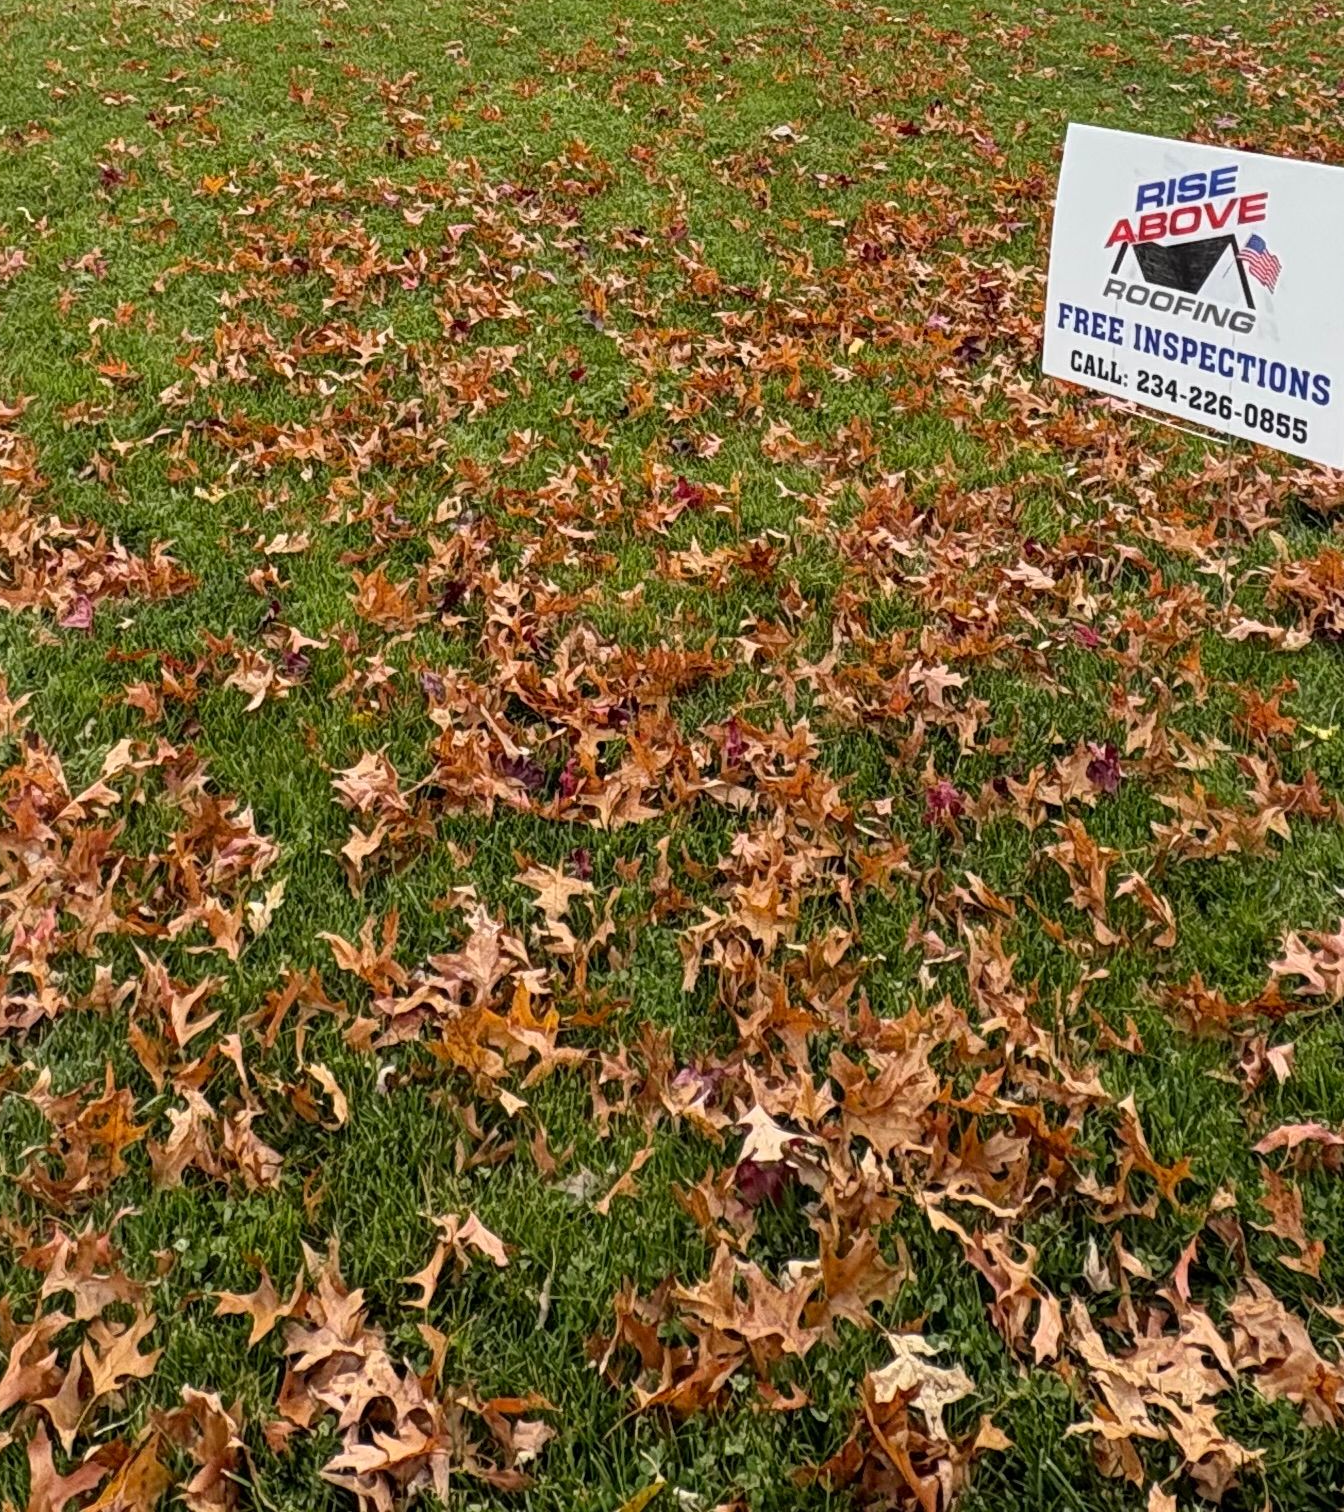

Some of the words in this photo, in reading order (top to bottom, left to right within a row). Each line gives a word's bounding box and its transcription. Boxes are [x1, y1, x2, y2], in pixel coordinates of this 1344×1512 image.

[1136, 165, 1238, 212] RISE
[1104, 192, 1268, 248] ABOVE
[1103, 278, 1256, 334] ROOFING
[1058, 303, 1124, 345] FREE
[1133, 323, 1331, 406] INSPECTIONS
[1070, 349, 1128, 387] CALL:
[1136, 370, 1308, 444] 234-226-0855
